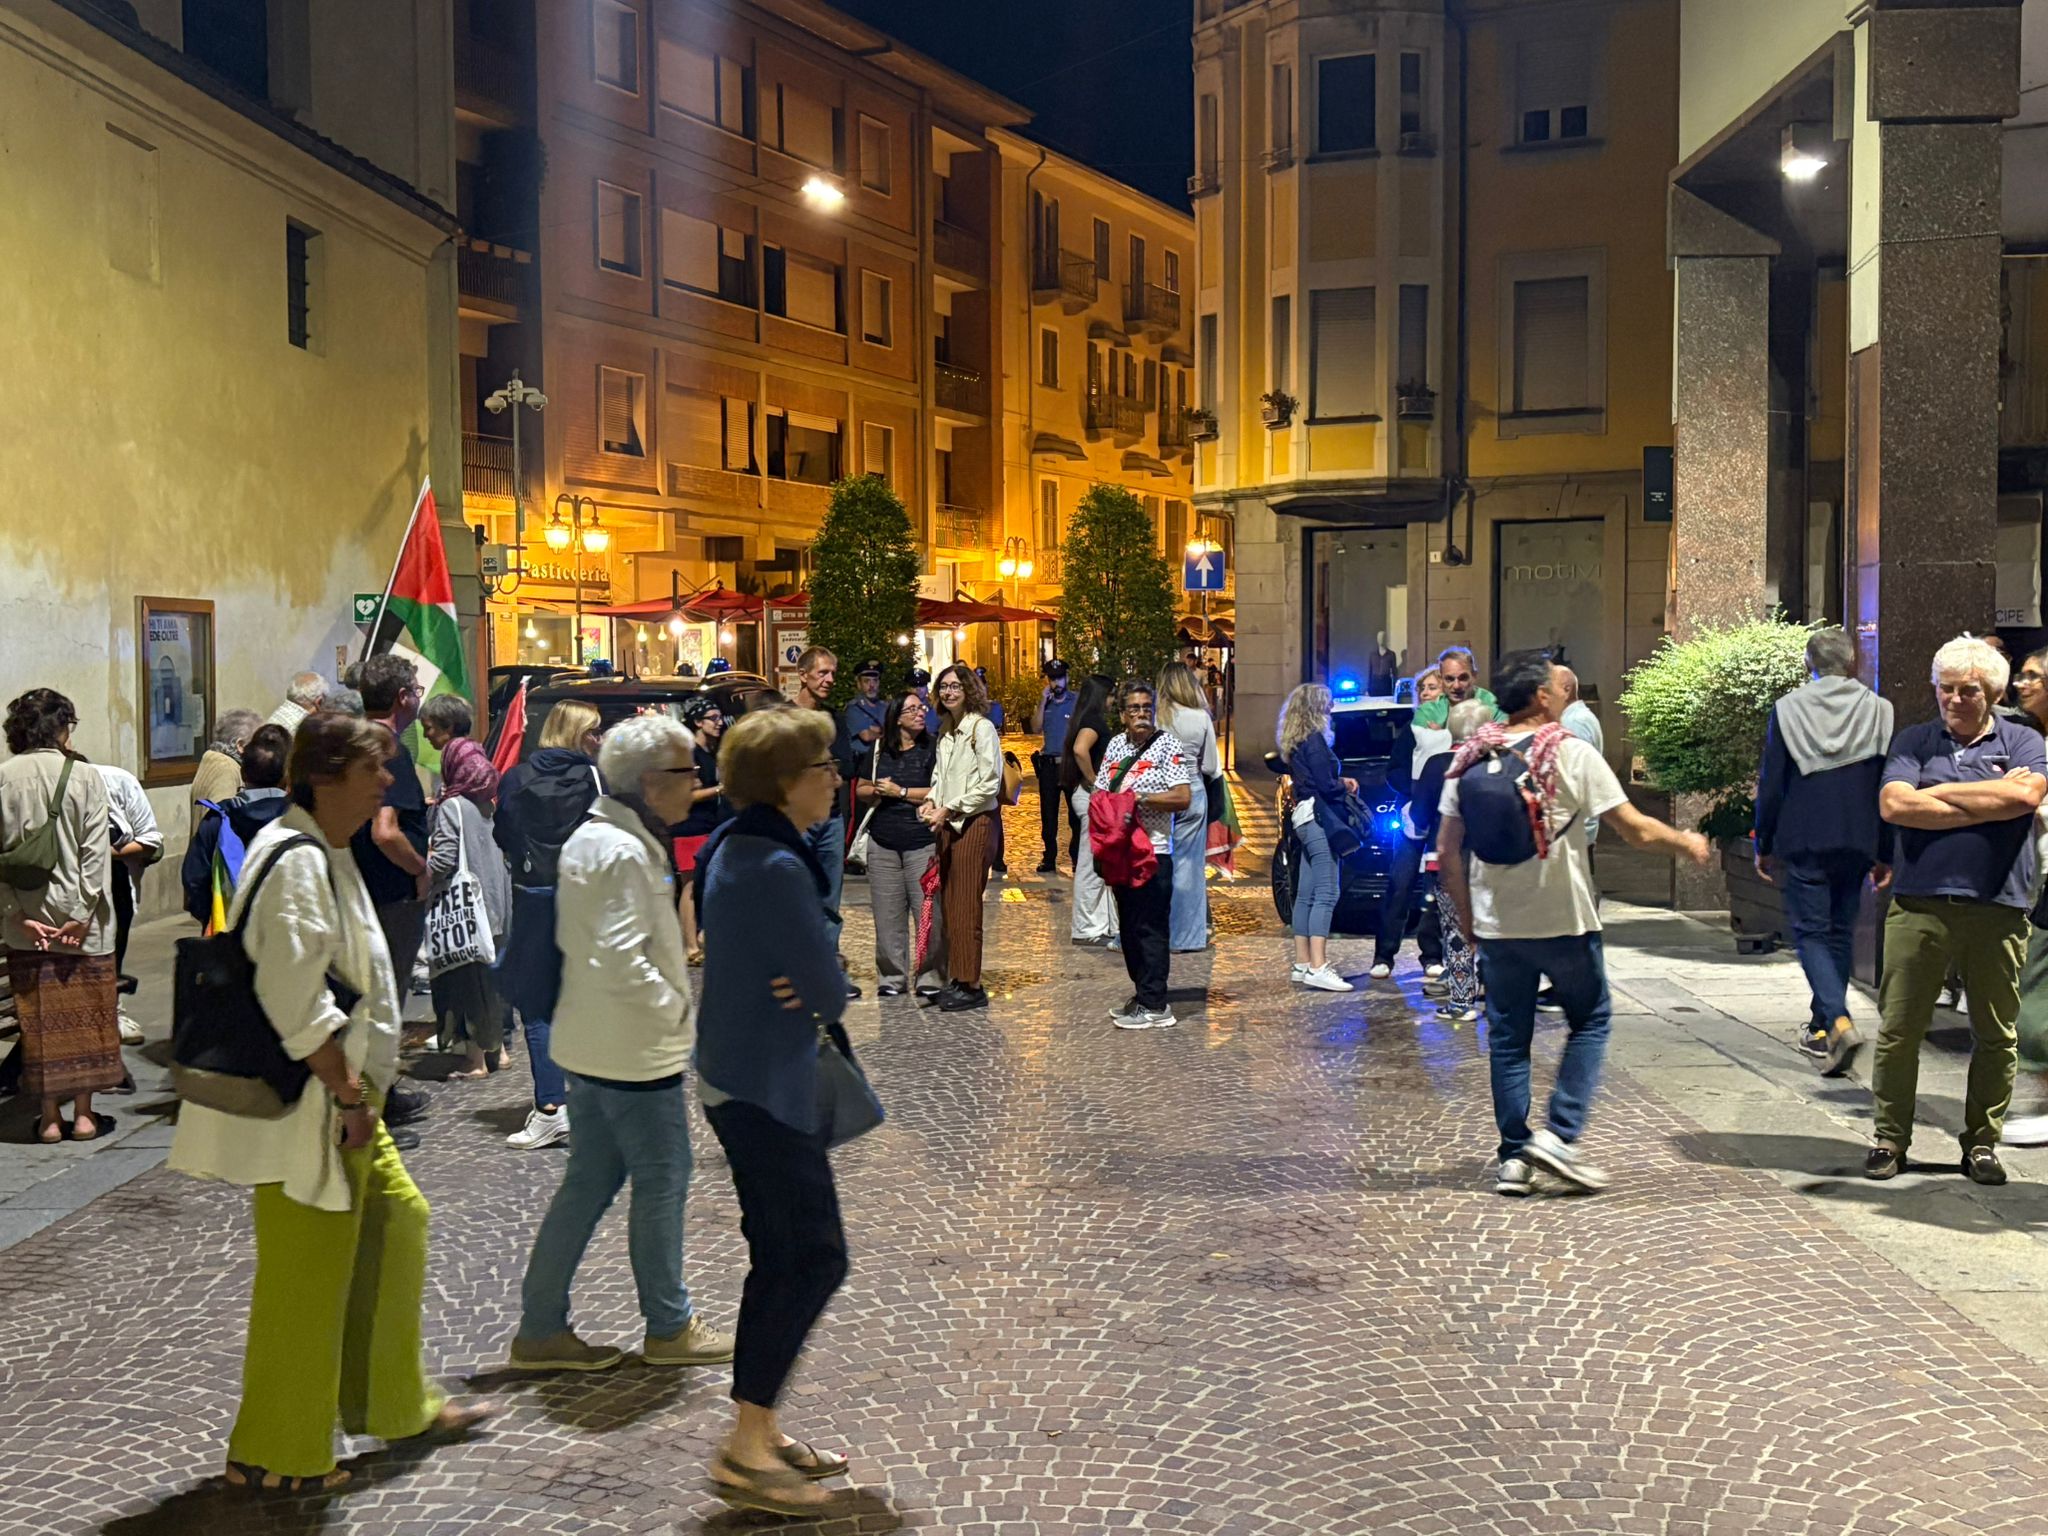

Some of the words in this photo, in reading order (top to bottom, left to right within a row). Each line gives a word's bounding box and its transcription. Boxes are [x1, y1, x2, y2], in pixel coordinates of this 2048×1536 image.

[483, 557, 497, 566] RPS
[520, 559, 609, 582] Pasticceria
[161, 630, 178, 641] OLTRE
[431, 881, 474, 920] FREE
[430, 908, 476, 932] PALESTINE
[431, 920, 477, 956] STOP
